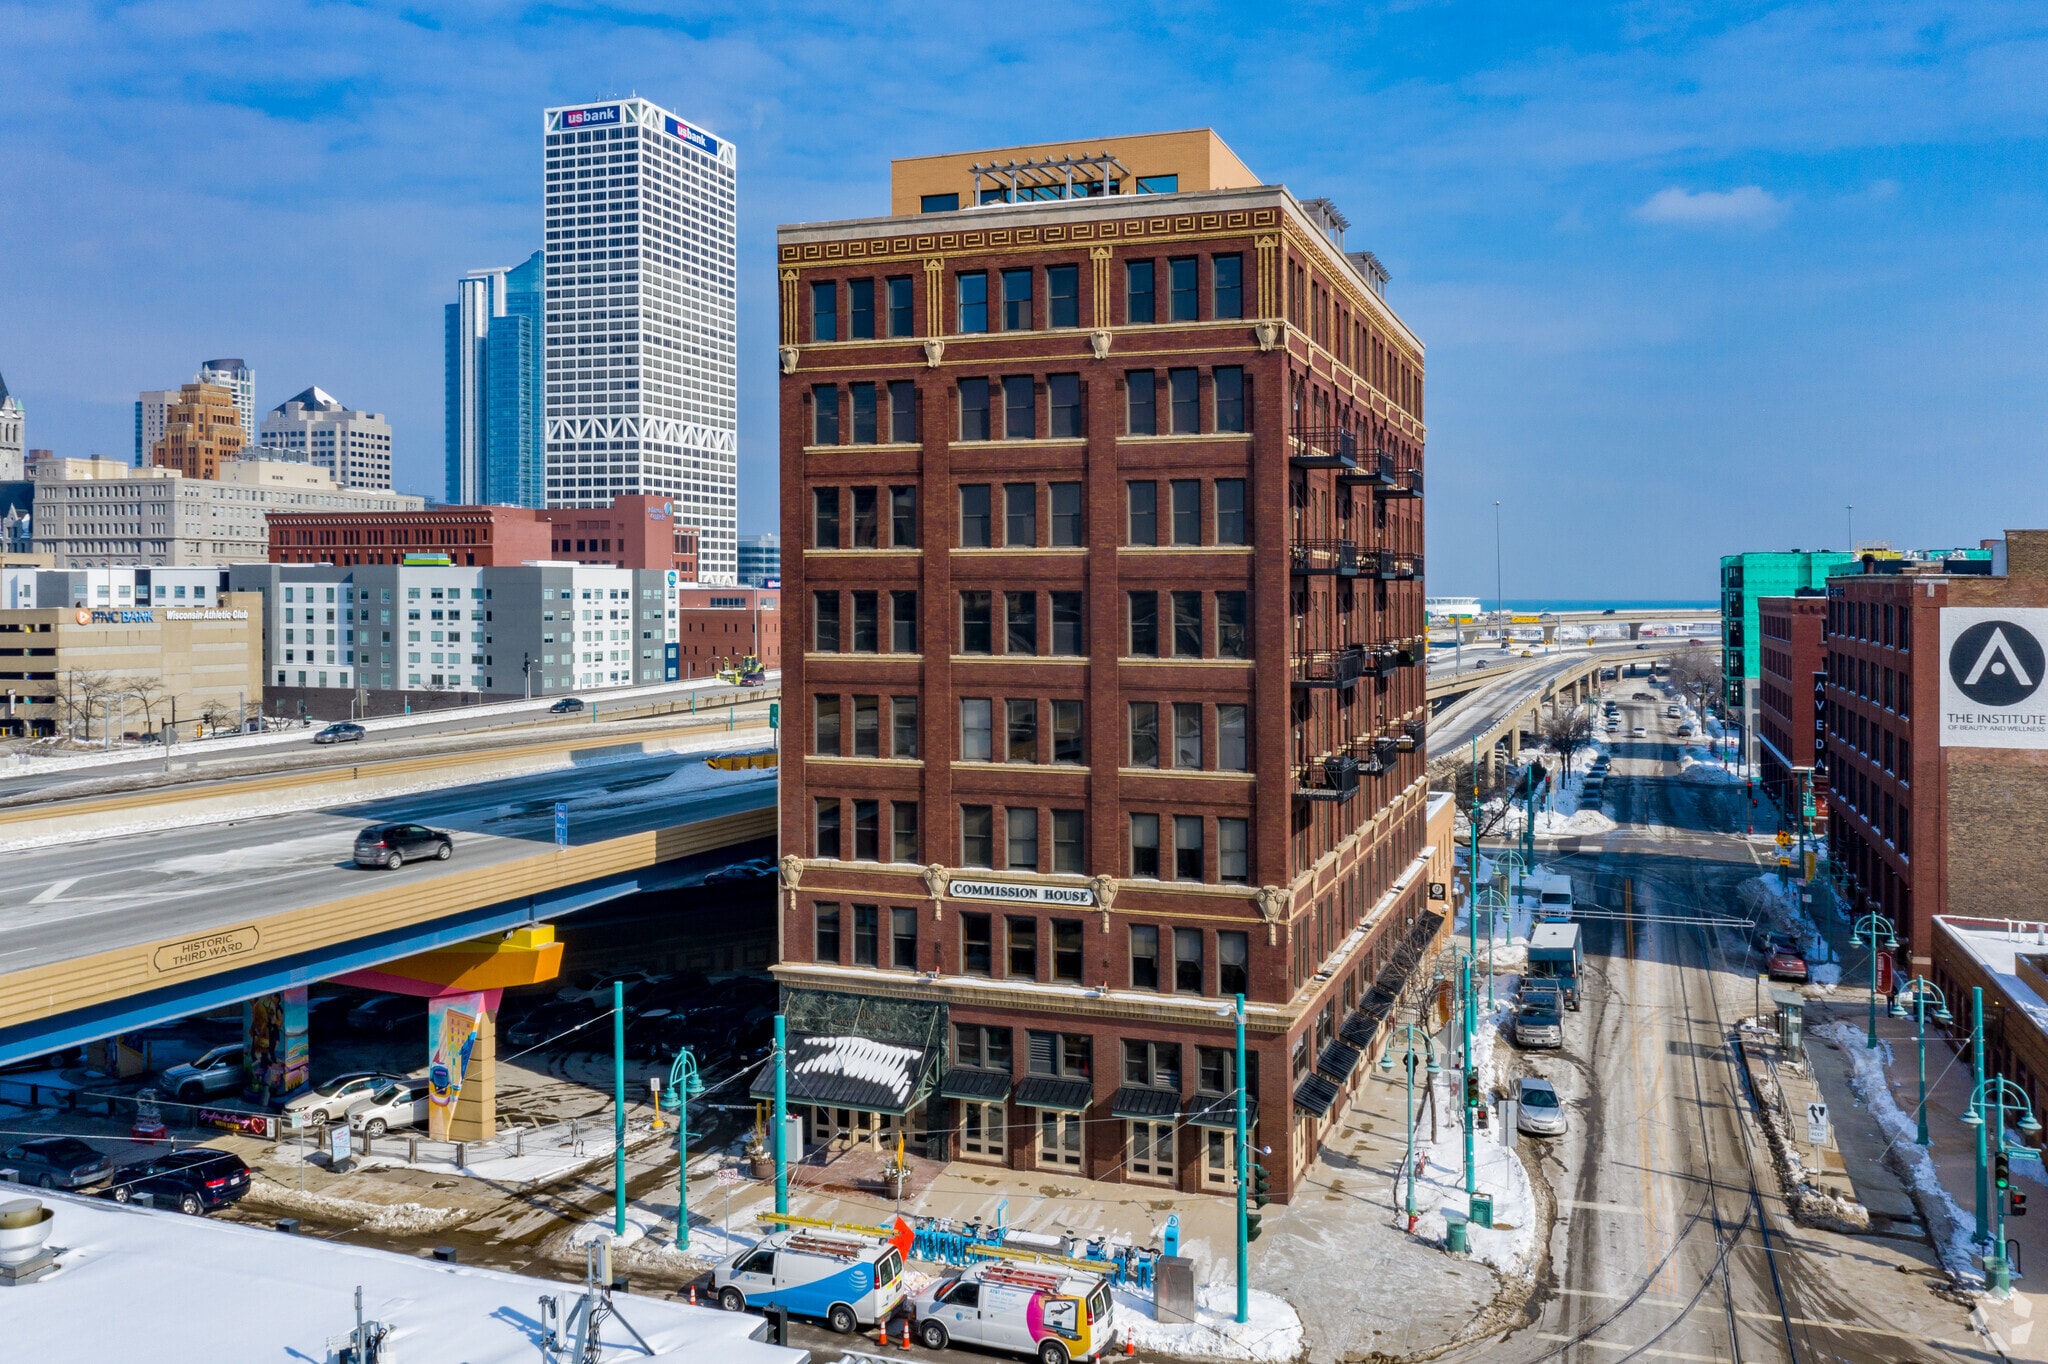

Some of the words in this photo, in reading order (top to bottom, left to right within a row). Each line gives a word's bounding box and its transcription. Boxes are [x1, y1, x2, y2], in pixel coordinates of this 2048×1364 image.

[92, 610, 119, 624] PNC
[121, 609, 155, 623] BANK
[166, 610, 202, 621] Wisconsin
[203, 610, 232, 620] Athletic
[233, 610, 249, 620] Club
[1815, 681, 1825, 769] AVEDA
[1947, 713, 1974, 724] THE
[1977, 713, 2047, 725] INSTITUTE
[2007, 725, 2046, 733] WELLNESS
[954, 883, 1038, 898] COMMISSION
[1044, 889, 1088, 903] HOUSE
[182, 934, 233, 953] HISTORIC
[209, 941, 243, 956] WARD
[172, 950, 207, 966] THIRD
